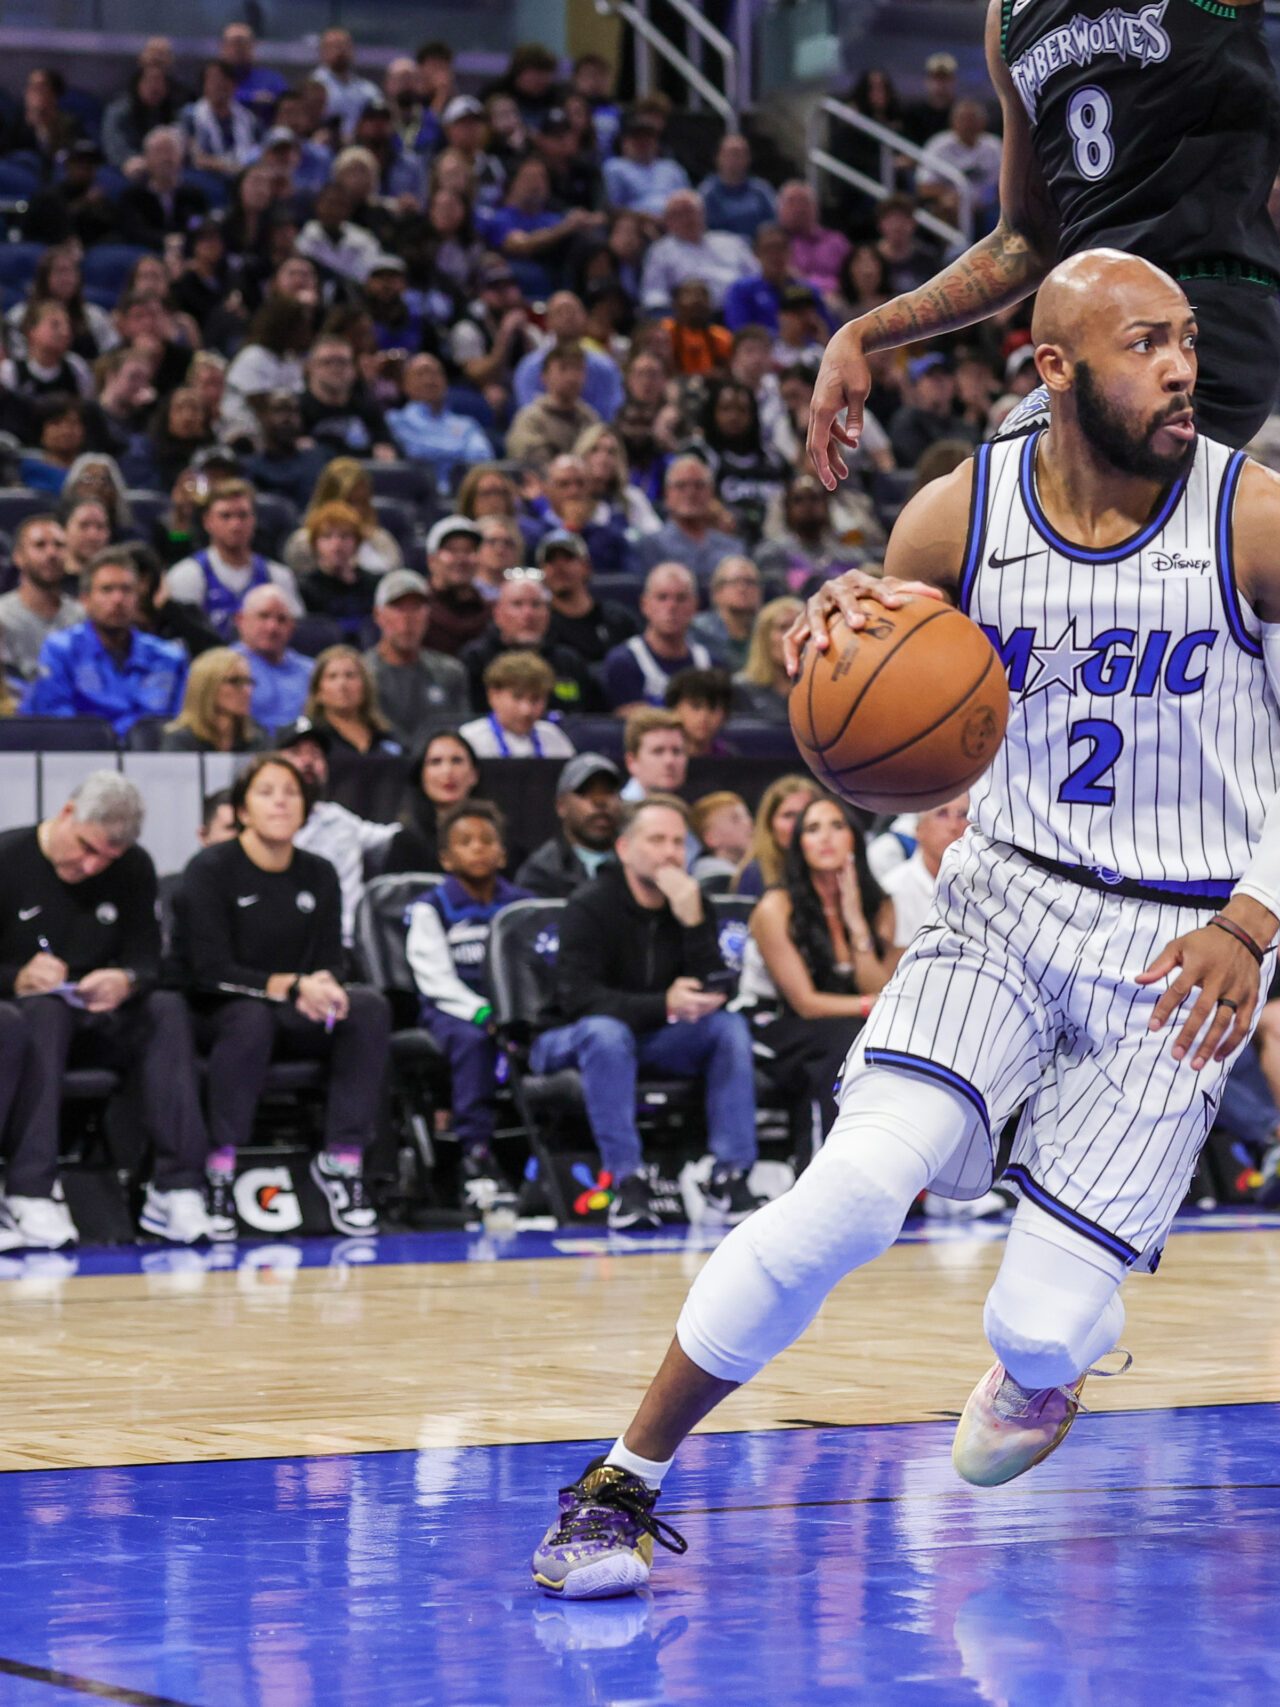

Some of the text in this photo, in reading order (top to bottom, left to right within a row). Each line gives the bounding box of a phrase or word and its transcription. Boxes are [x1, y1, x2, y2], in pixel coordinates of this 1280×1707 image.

[1066, 84, 1115, 182] 8
[1147, 551, 1211, 575] Disney
[1057, 718, 1124, 807] 2
[234, 1166, 303, 1232] G
